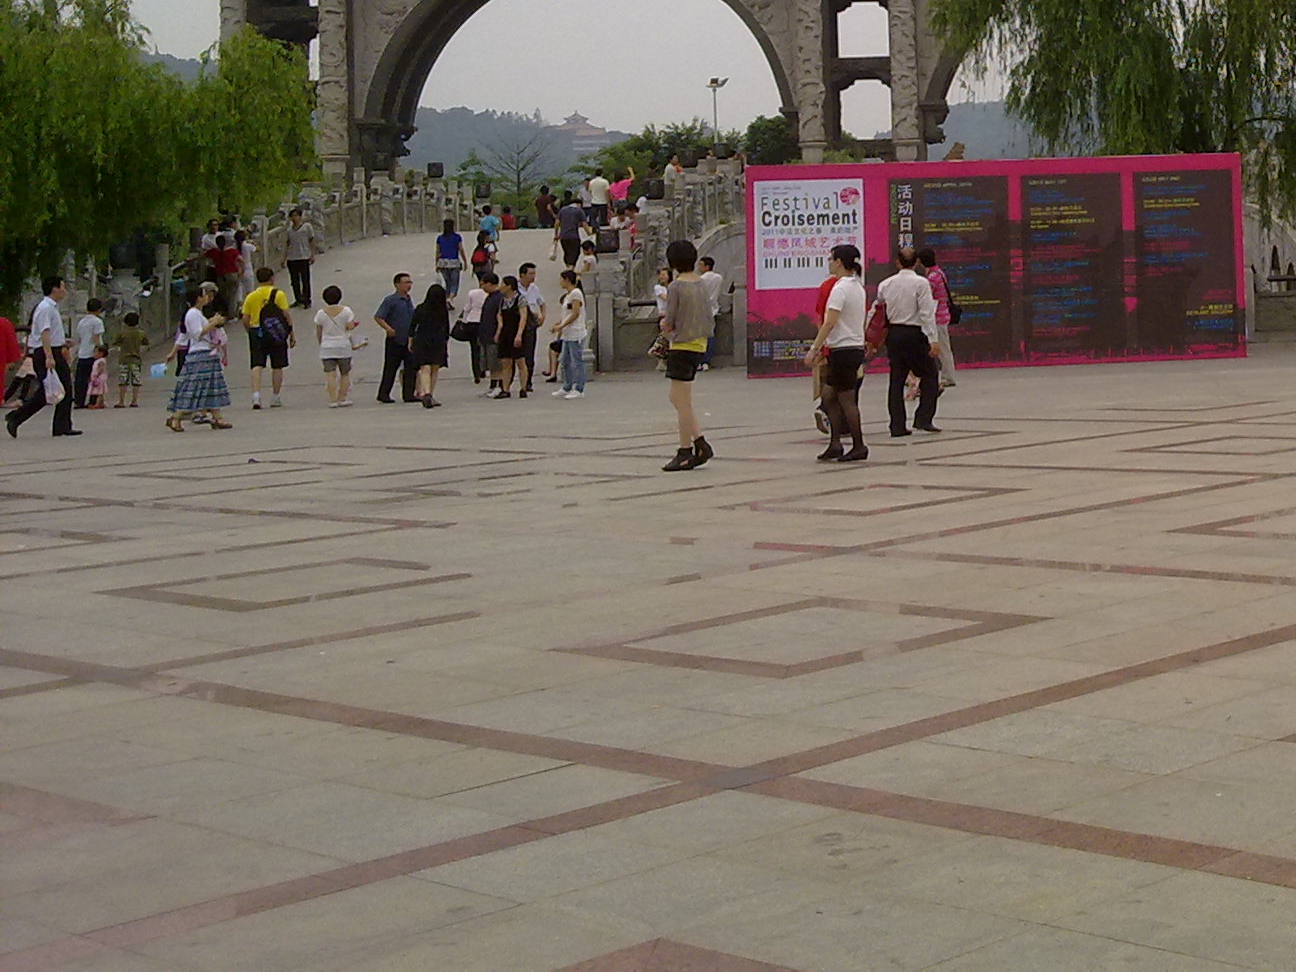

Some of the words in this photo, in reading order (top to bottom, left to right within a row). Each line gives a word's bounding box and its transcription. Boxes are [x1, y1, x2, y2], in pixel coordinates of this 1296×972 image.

[761, 192, 838, 210] Festival
[762, 209, 857, 226] Croisement
[898, 185, 913, 247] 活动日程
